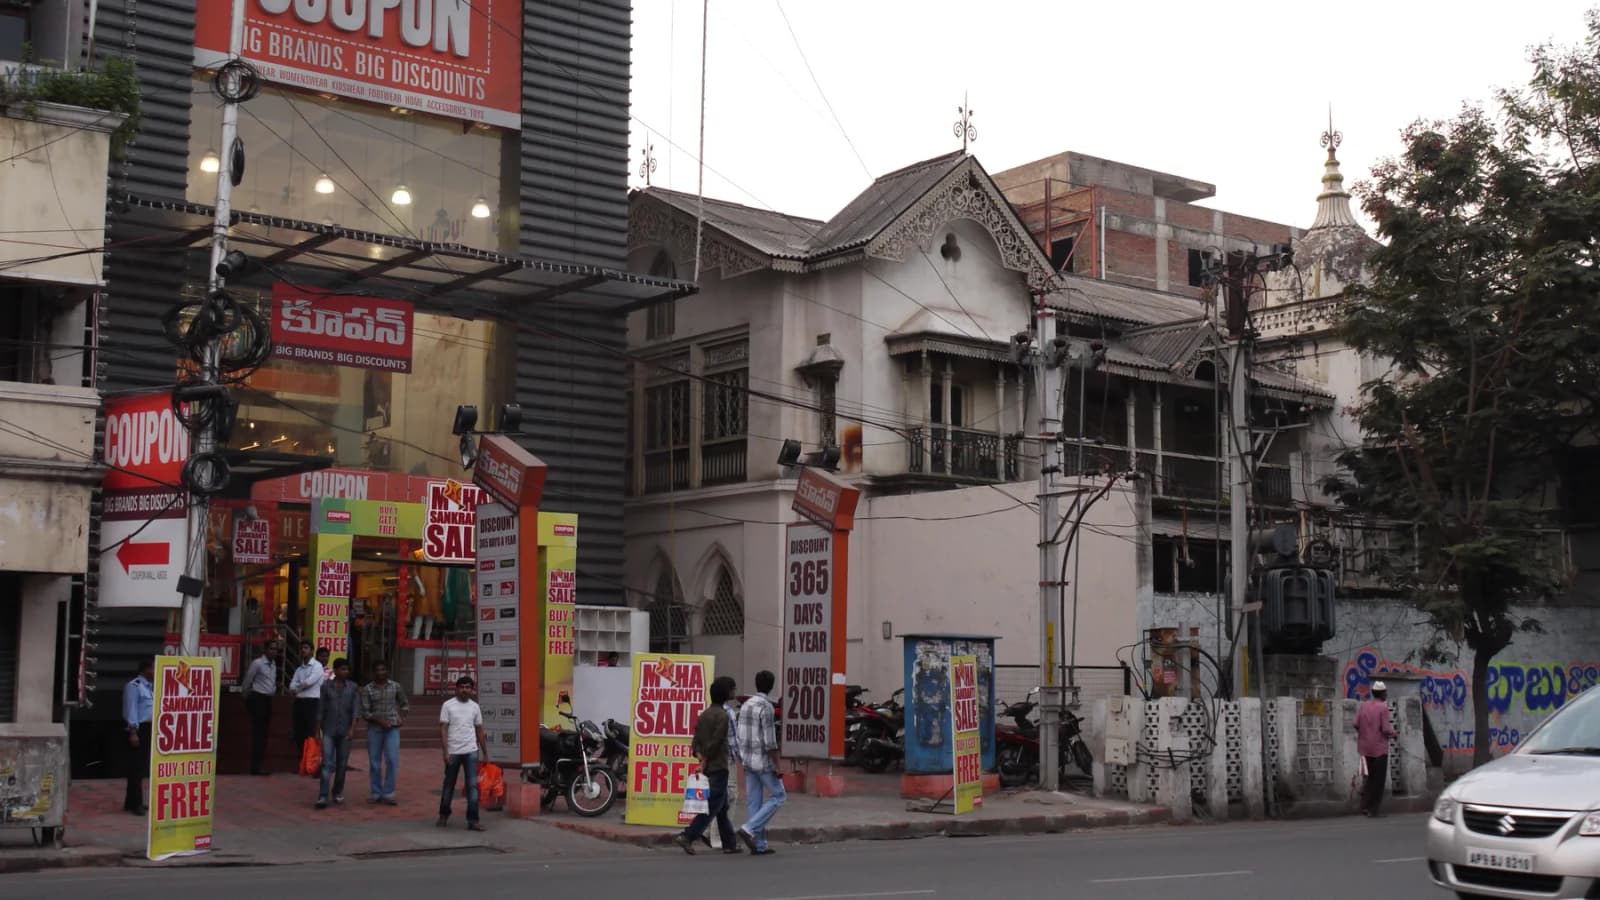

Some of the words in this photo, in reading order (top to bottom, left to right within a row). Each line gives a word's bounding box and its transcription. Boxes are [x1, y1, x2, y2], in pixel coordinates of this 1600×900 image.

[243, 25, 263, 53] IG
[269, 31, 348, 72] BRANDS.
[355, 50, 386, 80] BIG
[391, 57, 486, 101] DISCOUNTS
[281, 299, 406, 345] కూపన్
[275, 345, 293, 356] BIG
[295, 347, 334, 361] BRANDS
[337, 352, 354, 363] BIG
[355, 355, 407, 370] DISCOUNTS
[103, 407, 189, 468] COUPON
[300, 471, 369, 500] COUPON
[480, 515, 515, 533] DISCOUNT
[235, 539, 269, 554] SALE
[426, 525, 476, 558] SAL
[791, 538, 829, 555] DISCOUNT
[790, 560, 829, 597] 365
[318, 580, 349, 597] SALE
[548, 588, 576, 604] SALE
[318, 603, 341, 617] BUY
[549, 609, 568, 621] BUY
[794, 603, 823, 625] DAYS
[317, 619, 340, 634] GET
[549, 625, 567, 638] GET
[316, 637, 347, 653] FREE
[549, 641, 575, 655] FREE
[788, 632, 797, 653] A
[799, 631, 827, 653] YEAR
[787, 667, 800, 685] ON
[802, 667, 828, 686] OVER
[162, 696, 213, 713] SANKRANTI
[641, 688, 704, 702] SANKRANTI
[787, 686, 826, 721] 200
[955, 700, 979, 730] SALE
[159, 712, 213, 752] SALE
[786, 724, 826, 744] BRANDS
[636, 743, 660, 757] BUY
[664, 743, 668, 757] 1
[158, 762, 178, 778] BUY
[180, 764, 185, 776] 1
[187, 760, 206, 775] GET
[208, 759, 212, 774] 1
[957, 753, 980, 784] FREE
[157, 781, 211, 821] FREE
